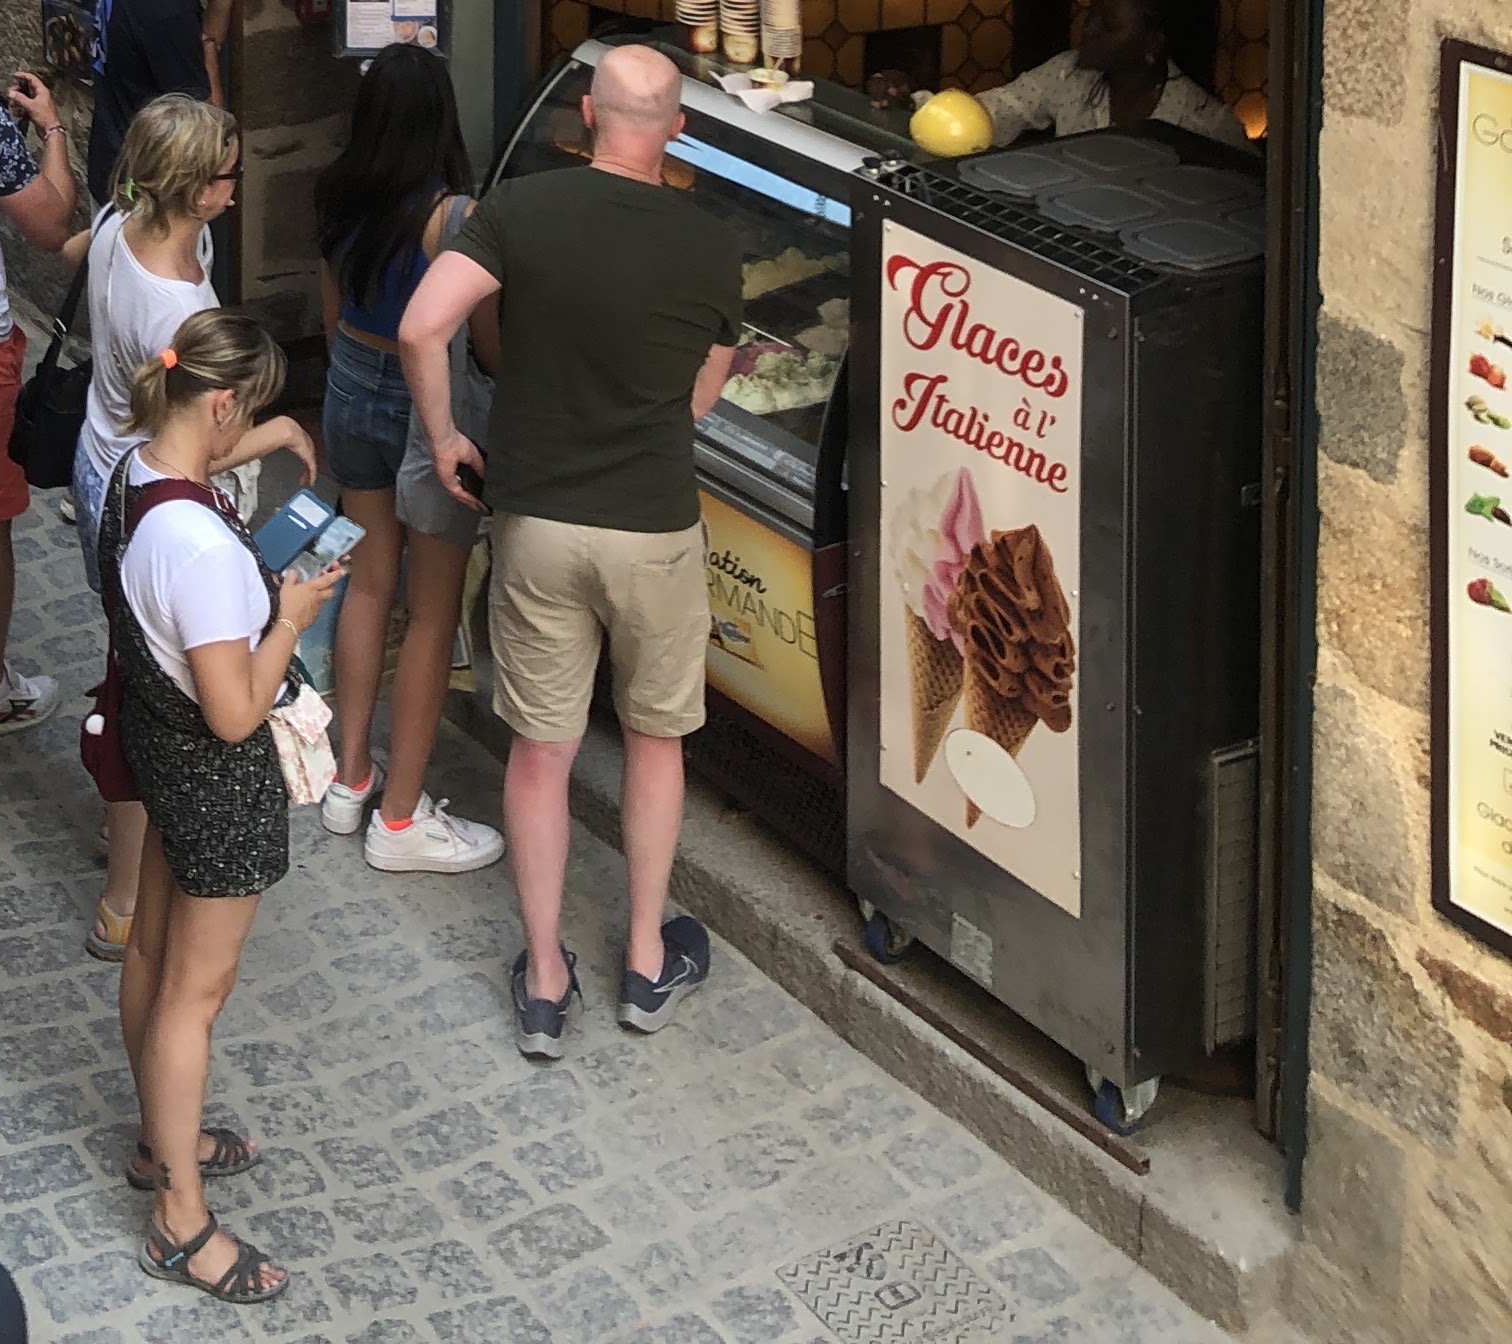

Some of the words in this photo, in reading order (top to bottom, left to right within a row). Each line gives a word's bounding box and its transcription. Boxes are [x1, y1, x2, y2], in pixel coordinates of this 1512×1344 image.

[886, 254, 1070, 398] Glaces
[891, 372, 1070, 493] Italienne
[1012, 396, 1033, 431] à
[704, 567, 819, 662] RMANDE
[708, 550, 768, 595] ation
